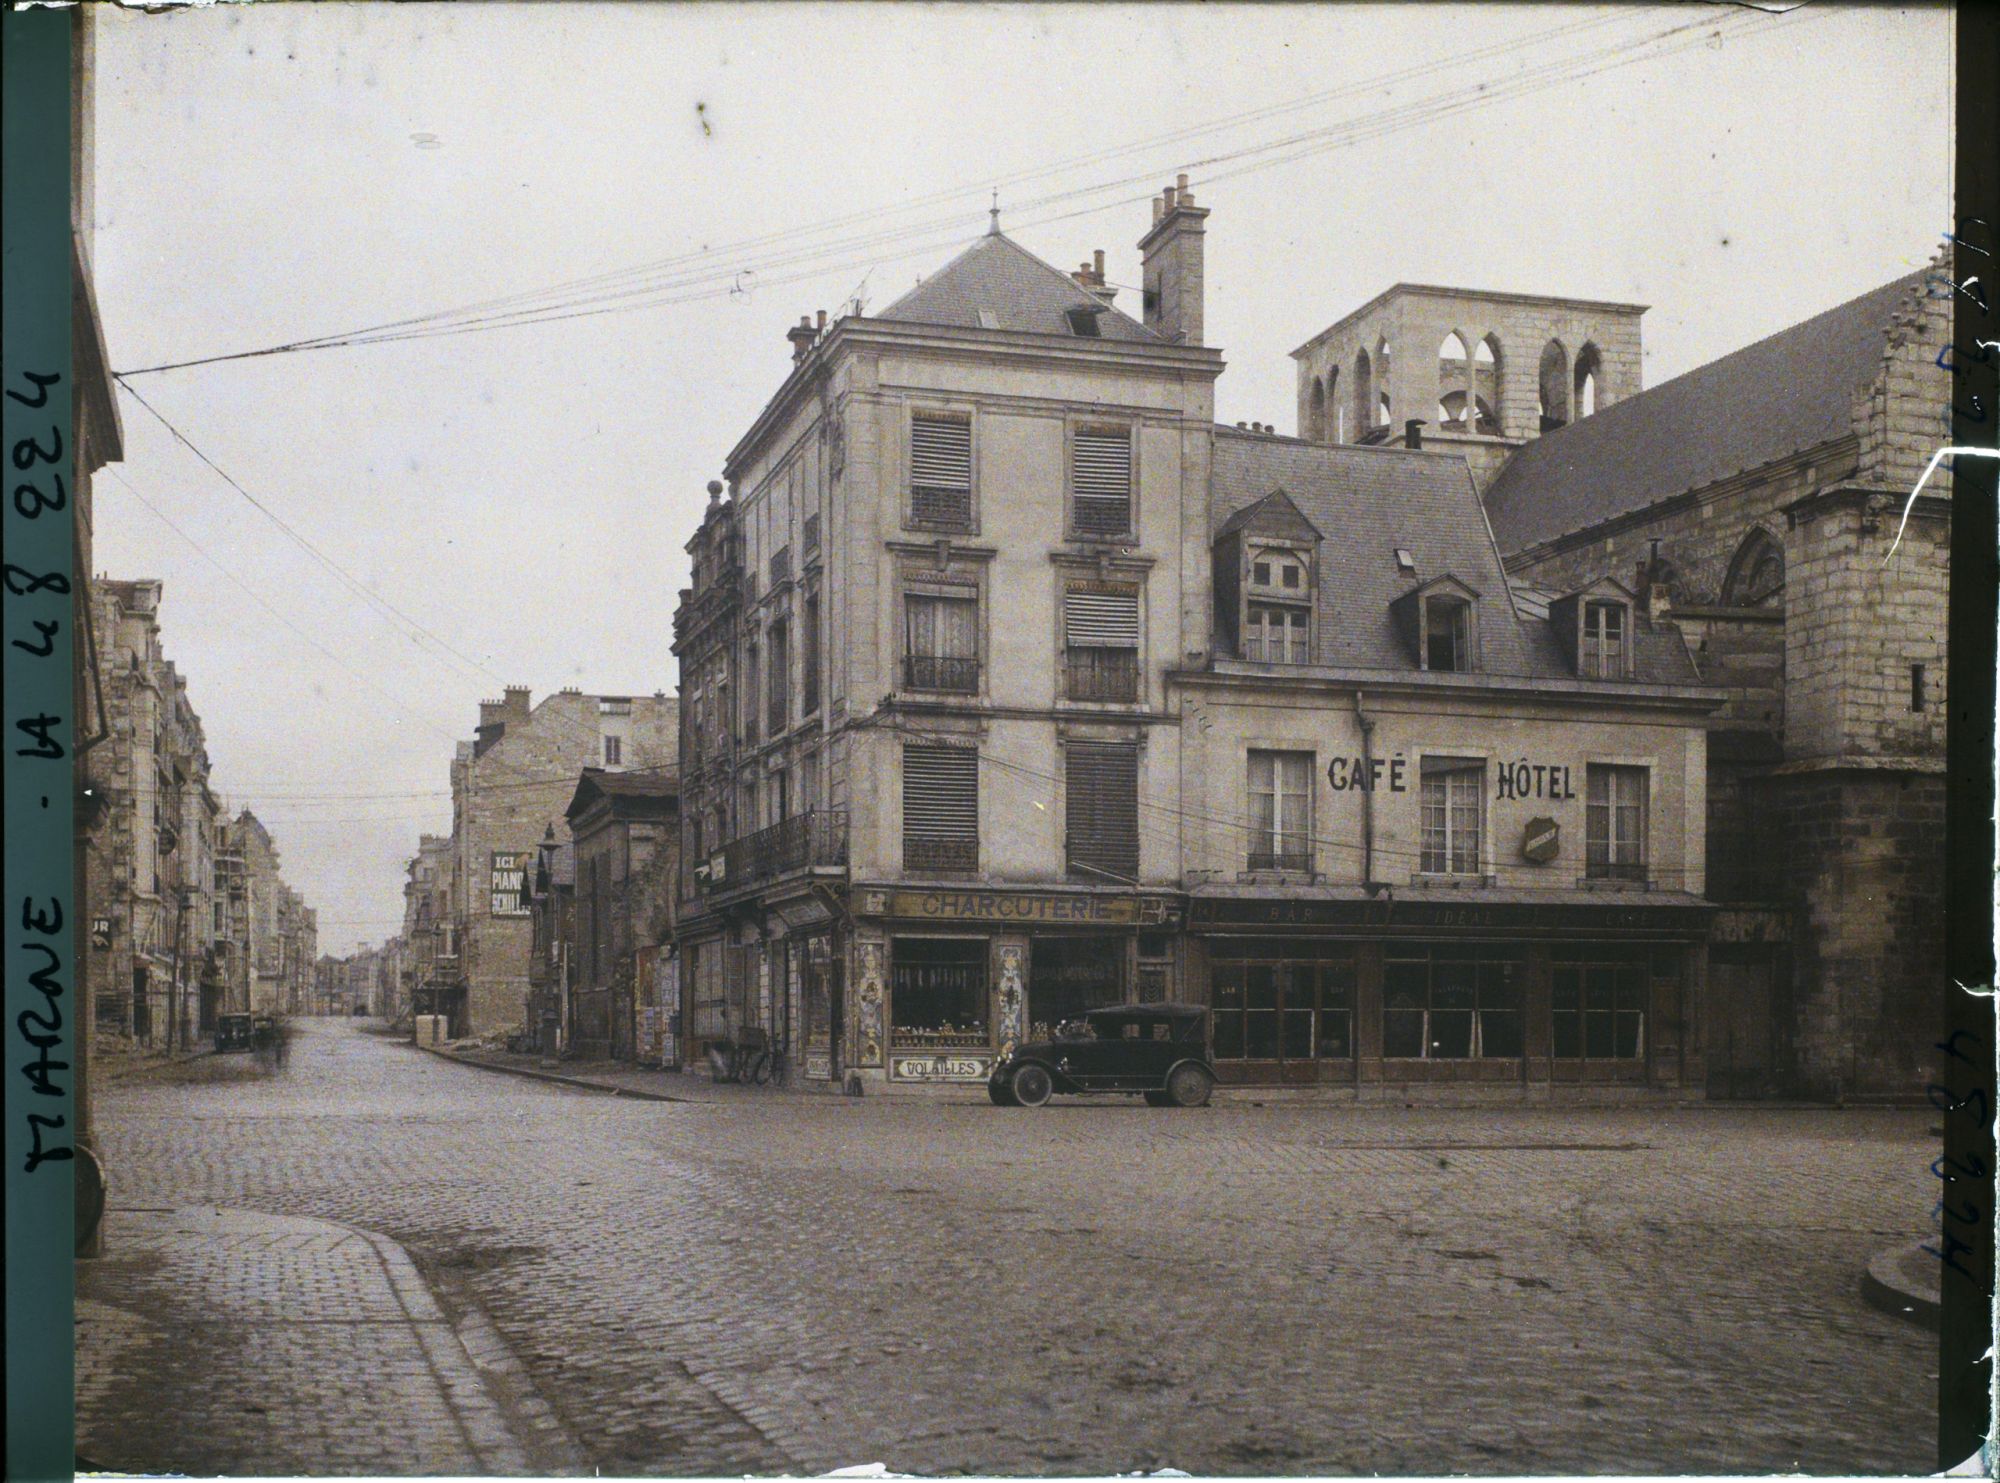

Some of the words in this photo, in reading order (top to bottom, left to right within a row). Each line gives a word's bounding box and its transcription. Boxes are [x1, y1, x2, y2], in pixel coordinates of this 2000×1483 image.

[1327, 753, 1406, 792] CAFÉ
[1496, 757, 1575, 800] HÔTEL
[495, 856, 515, 868] ICI
[922, 893, 1113, 920] CHARCUTERIE
[1269, 907, 1313, 921] BAR
[18, 897, 72, 1172] MARNE
